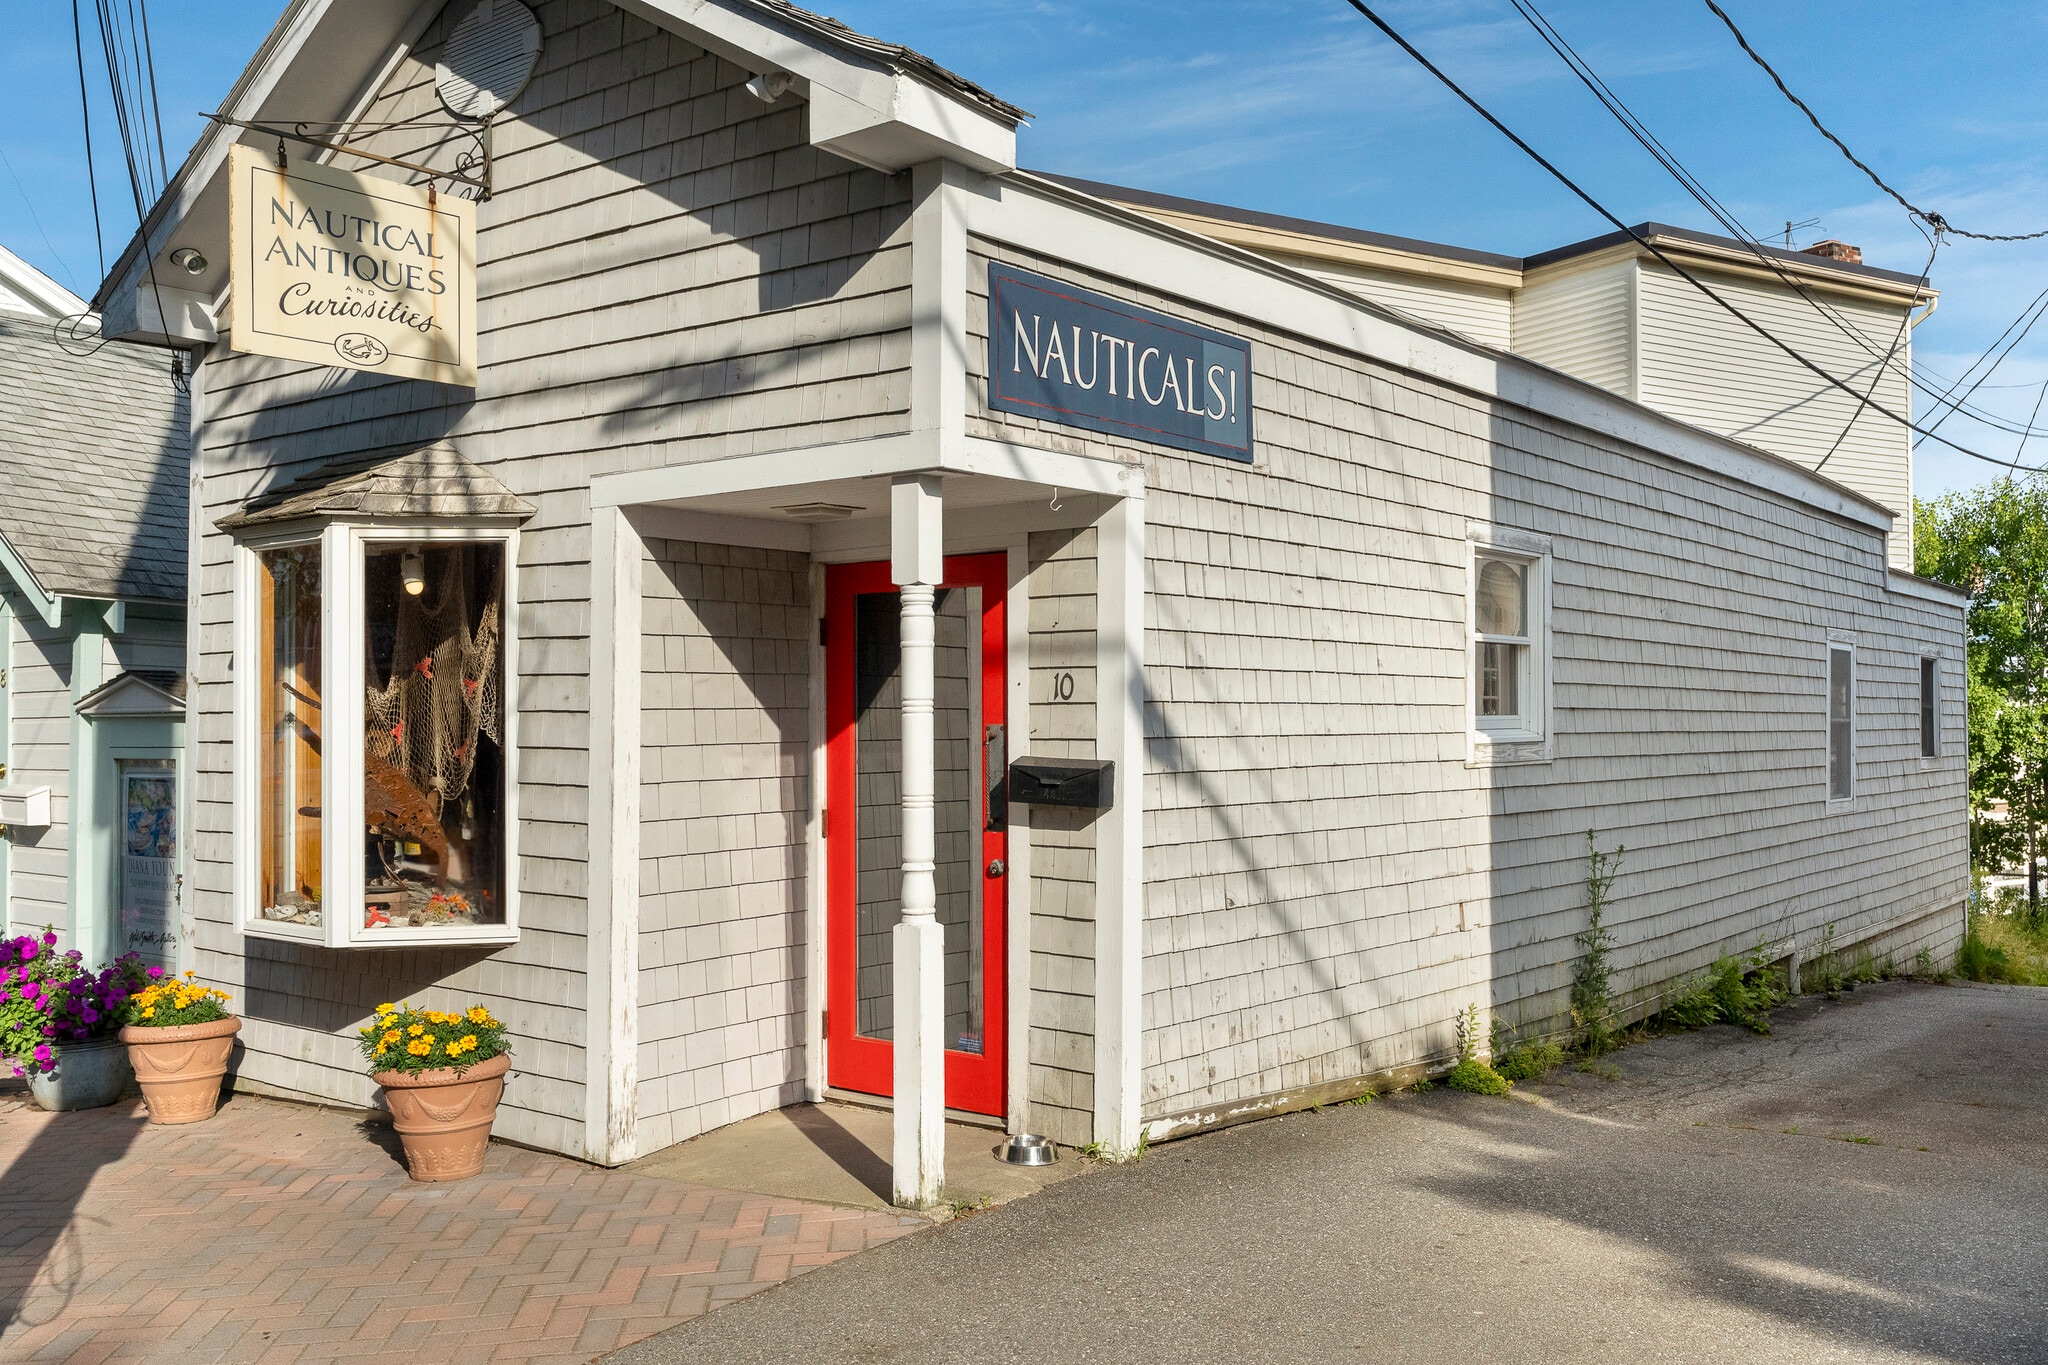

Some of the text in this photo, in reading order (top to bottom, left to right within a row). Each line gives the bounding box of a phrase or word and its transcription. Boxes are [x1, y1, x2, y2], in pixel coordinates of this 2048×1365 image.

[271, 196, 445, 260] NAUTICAL
[264, 235, 446, 295] ANTIQUES
[278, 282, 442, 333] Curiosities
[345, 285, 375, 296] AND
[1012, 306, 1237, 424] NAUTICALS!
[1, 668, 7, 688] 8
[1053, 672, 1075, 700] 10
[128, 858, 149, 875] DIANA
